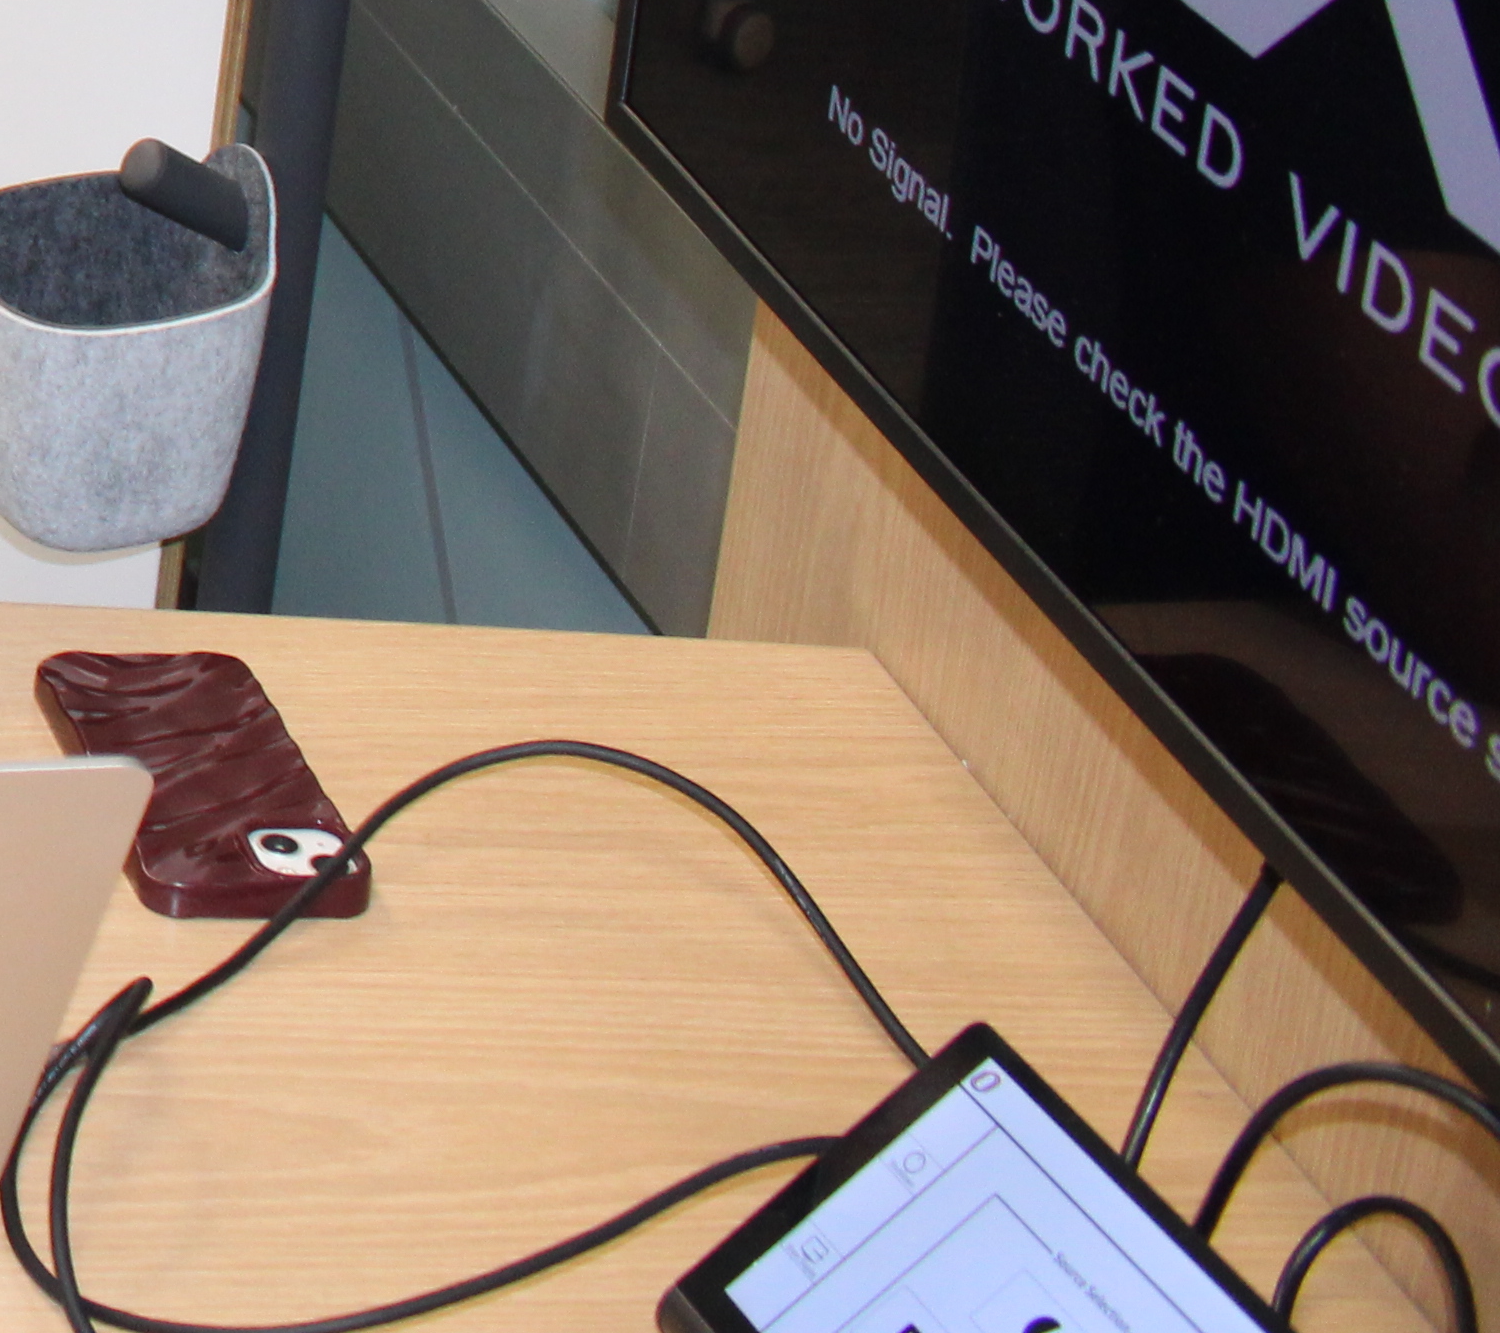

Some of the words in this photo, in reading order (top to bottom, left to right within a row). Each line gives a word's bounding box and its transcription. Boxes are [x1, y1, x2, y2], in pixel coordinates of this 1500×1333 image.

[828, 84, 864, 148] No
[869, 127, 953, 240] Signal.
[970, 223, 1068, 347] Please
[1074, 332, 1164, 450] check
[1172, 418, 1226, 503] the
[1232, 480, 1338, 613] HDMI
[1343, 594, 1479, 749] source
